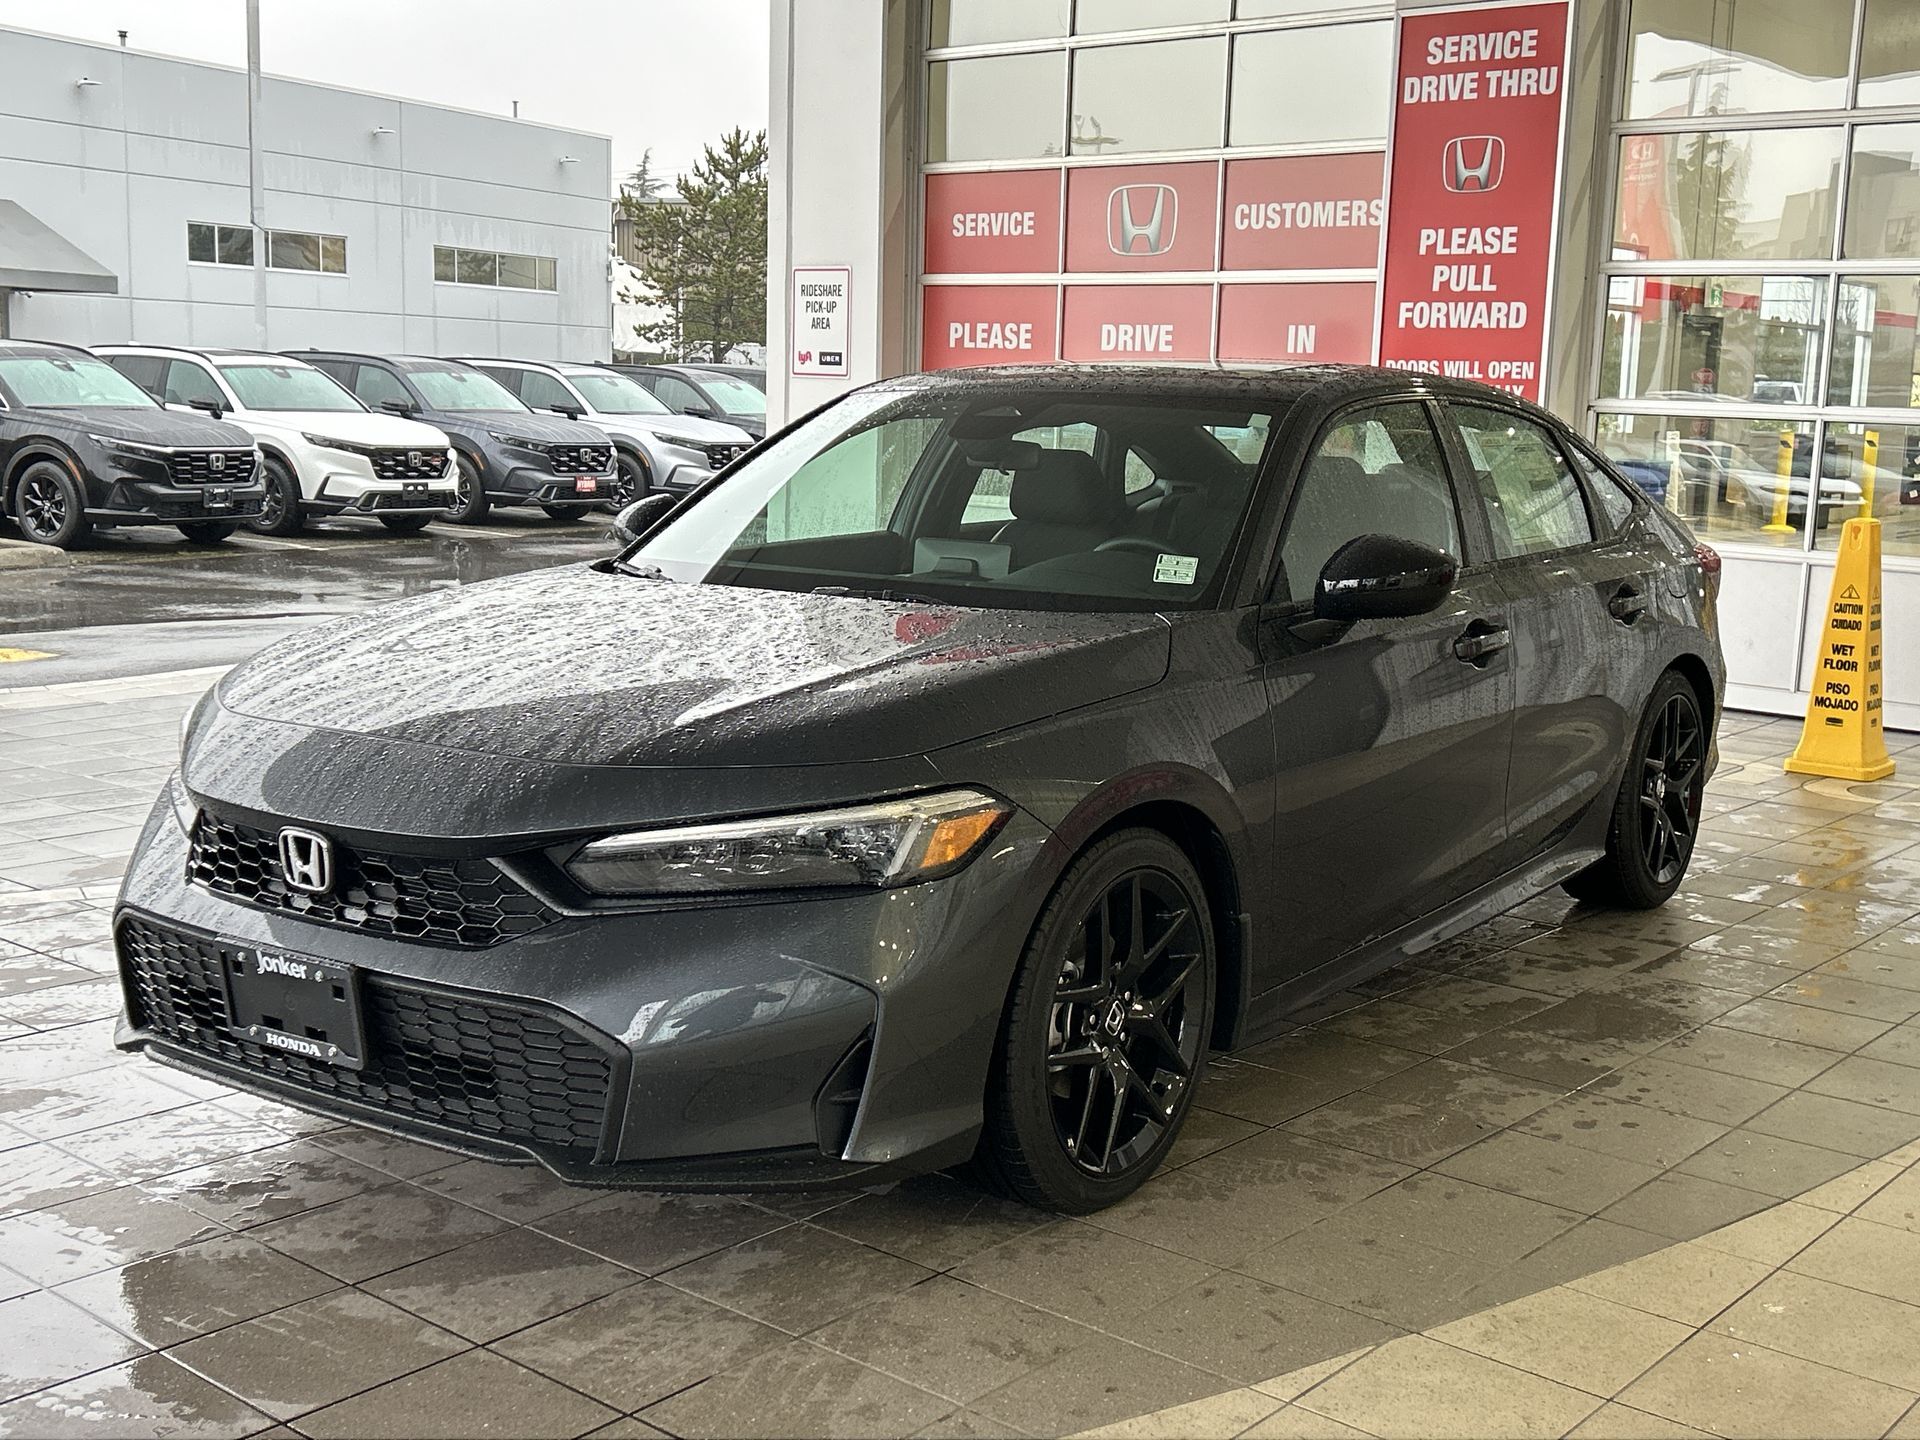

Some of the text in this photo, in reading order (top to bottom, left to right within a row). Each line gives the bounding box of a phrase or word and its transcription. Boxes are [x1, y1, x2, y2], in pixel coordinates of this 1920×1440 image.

[1427, 29, 1539, 65] SERVICE
[1403, 66, 1559, 104] DRIVE THRU
[952, 199, 1383, 237] SERVICE CUSTOMERS
[1419, 226, 1518, 255] PLEASE
[1432, 265, 1497, 292] PULL
[800, 284, 842, 297] RIDESHARE
[805, 301, 837, 313] PICK-UP
[1398, 301, 1528, 329] FORWARD
[811, 317, 831, 330] AREA
[949, 322, 1316, 354] PLEASE DRIVE IN
[821, 355, 841, 363] UBER
[1443, 360, 1483, 379] WILL
[1488, 361, 1535, 380] OPEN
[1834, 603, 1863, 615] CAUTION
[1831, 618, 1862, 631] CUIDADO
[1832, 644, 1855, 656] WET
[1824, 658, 1858, 672] FLOOR
[1826, 682, 1850, 696] PISO
[1814, 696, 1859, 712] MOJADO
[257, 949, 307, 979] Jonker
[266, 1032, 322, 1057] HONDA
